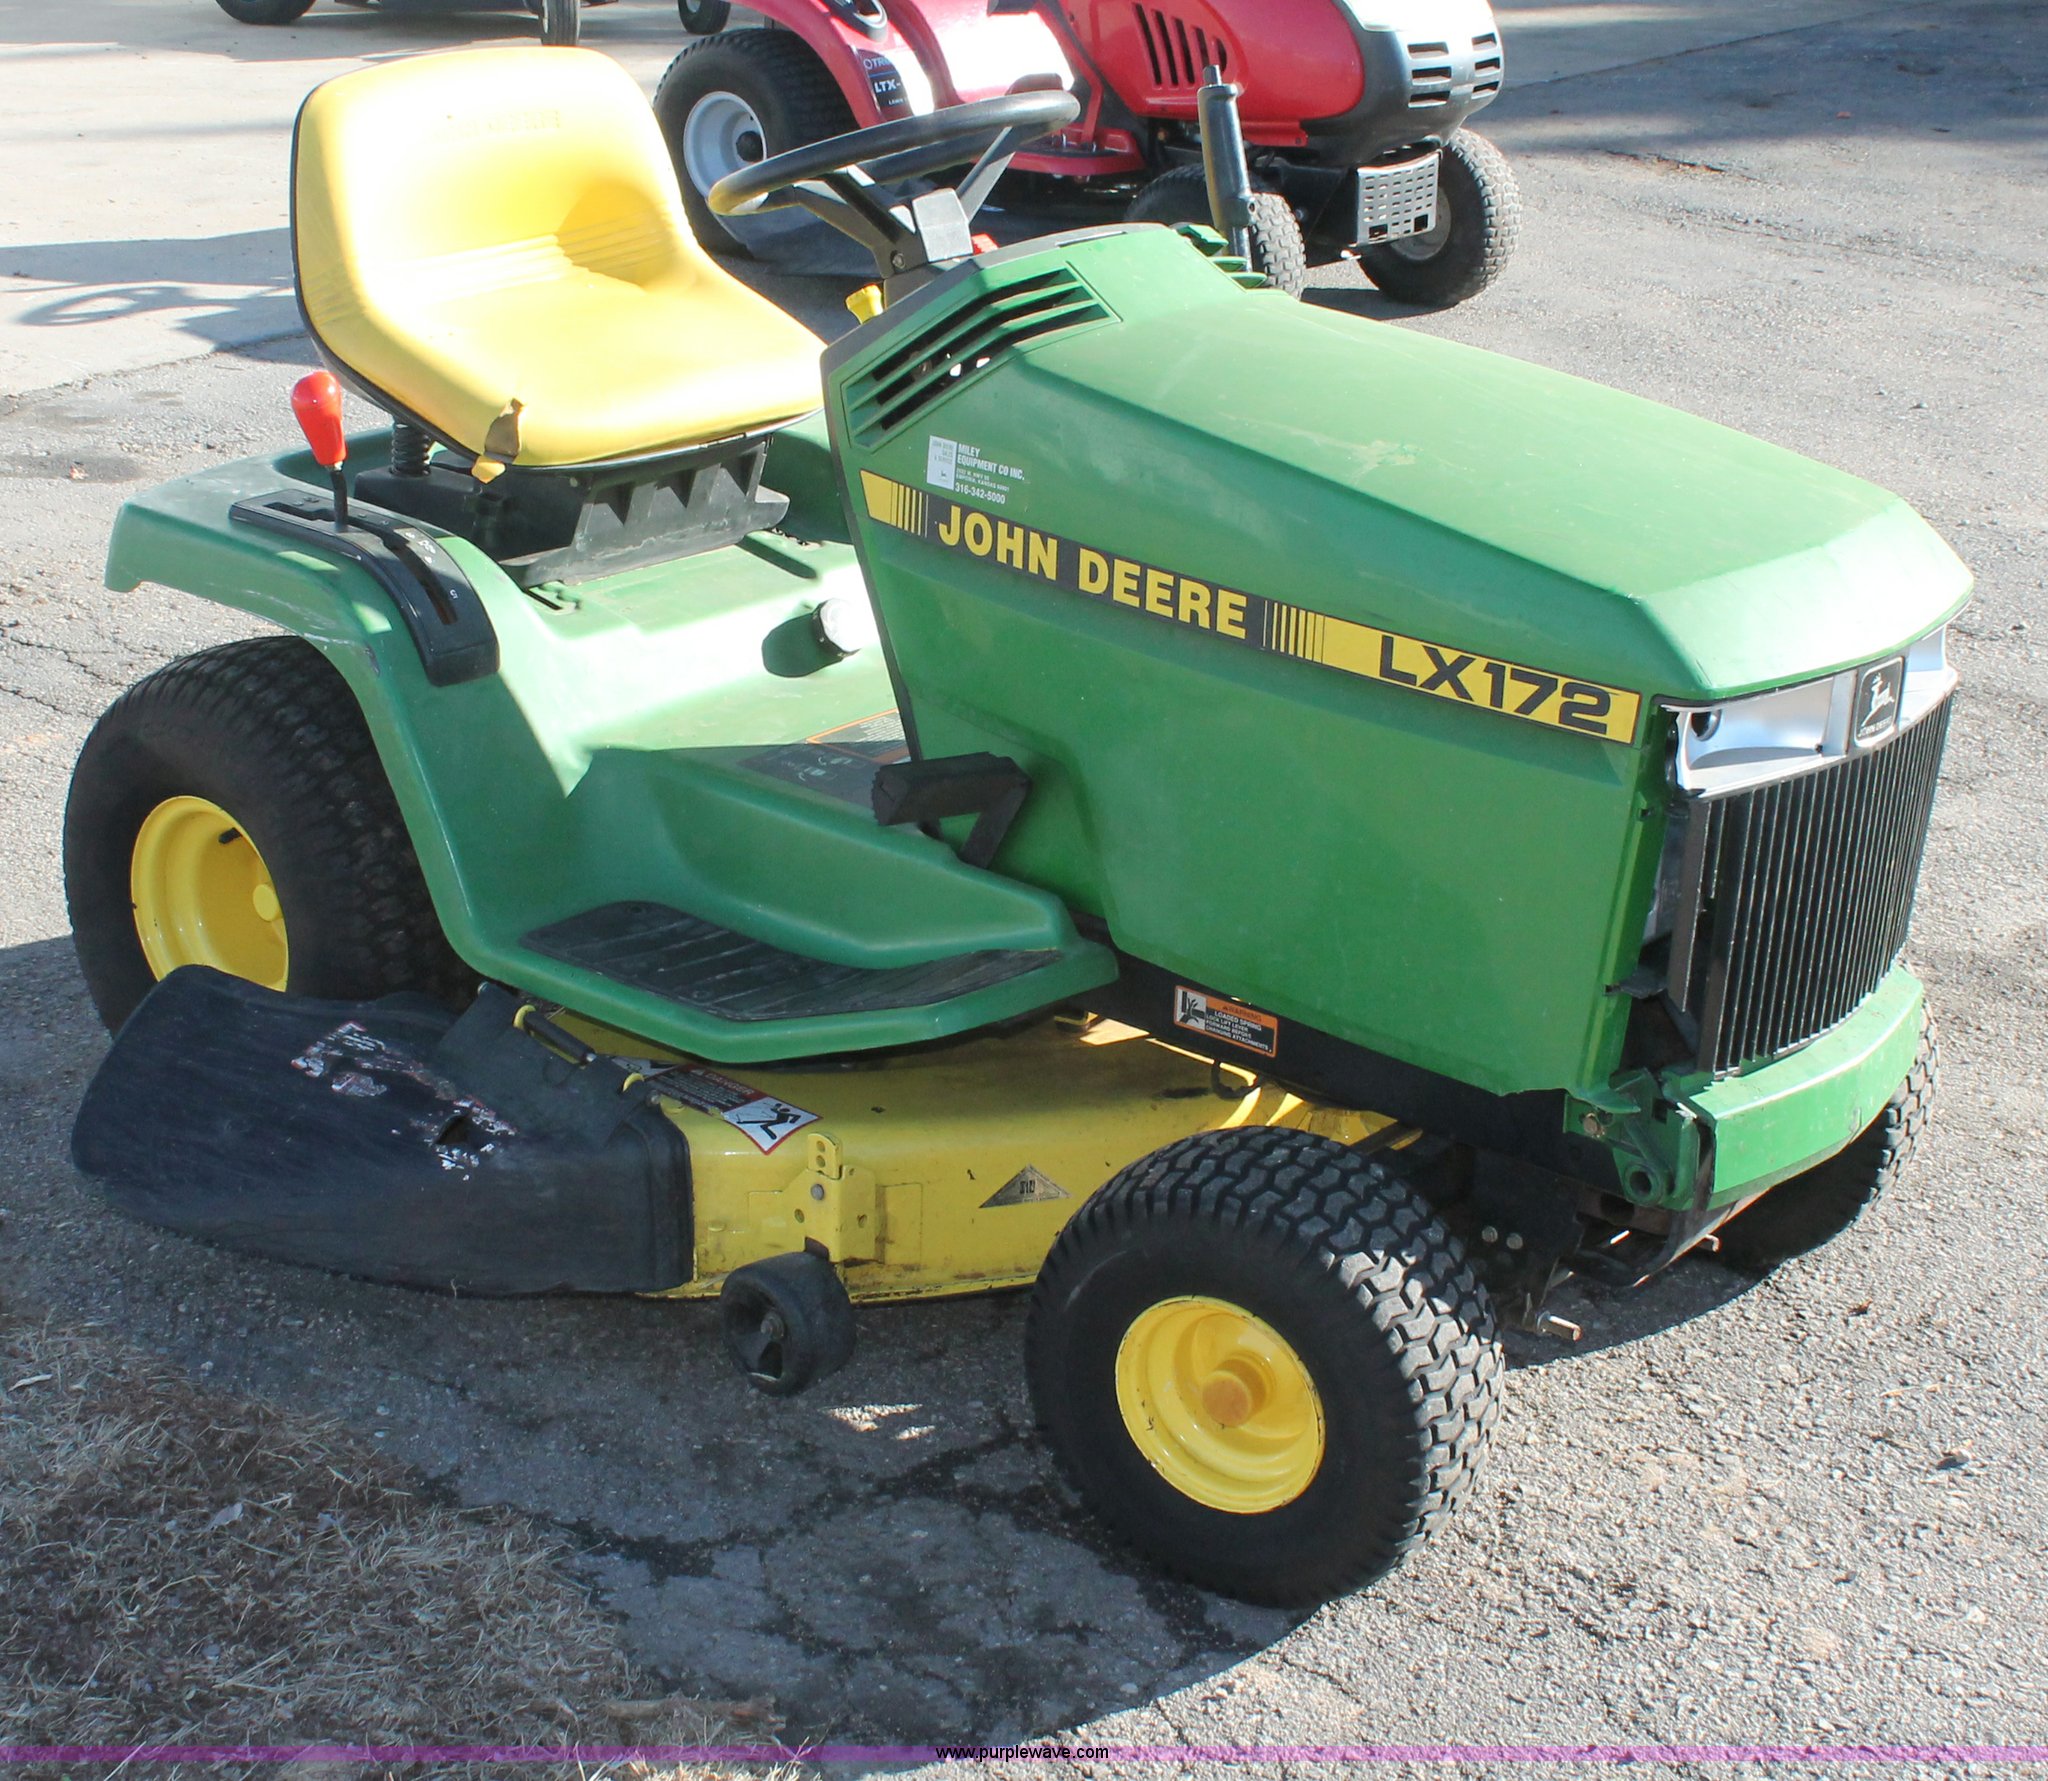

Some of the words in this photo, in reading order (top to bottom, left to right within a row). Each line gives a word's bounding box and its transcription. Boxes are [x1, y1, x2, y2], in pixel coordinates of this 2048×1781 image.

[958, 443, 980, 457] MILEY
[957, 454, 998, 473] EQUIPMENT
[998, 464, 1009, 476] CO
[1009, 467, 1025, 480] INC.
[955, 482, 1006, 504] 316-342-5000
[938, 505, 1058, 580] JOHN
[1079, 547, 1248, 639] DEERE
[1379, 634, 1612, 735] LX172
